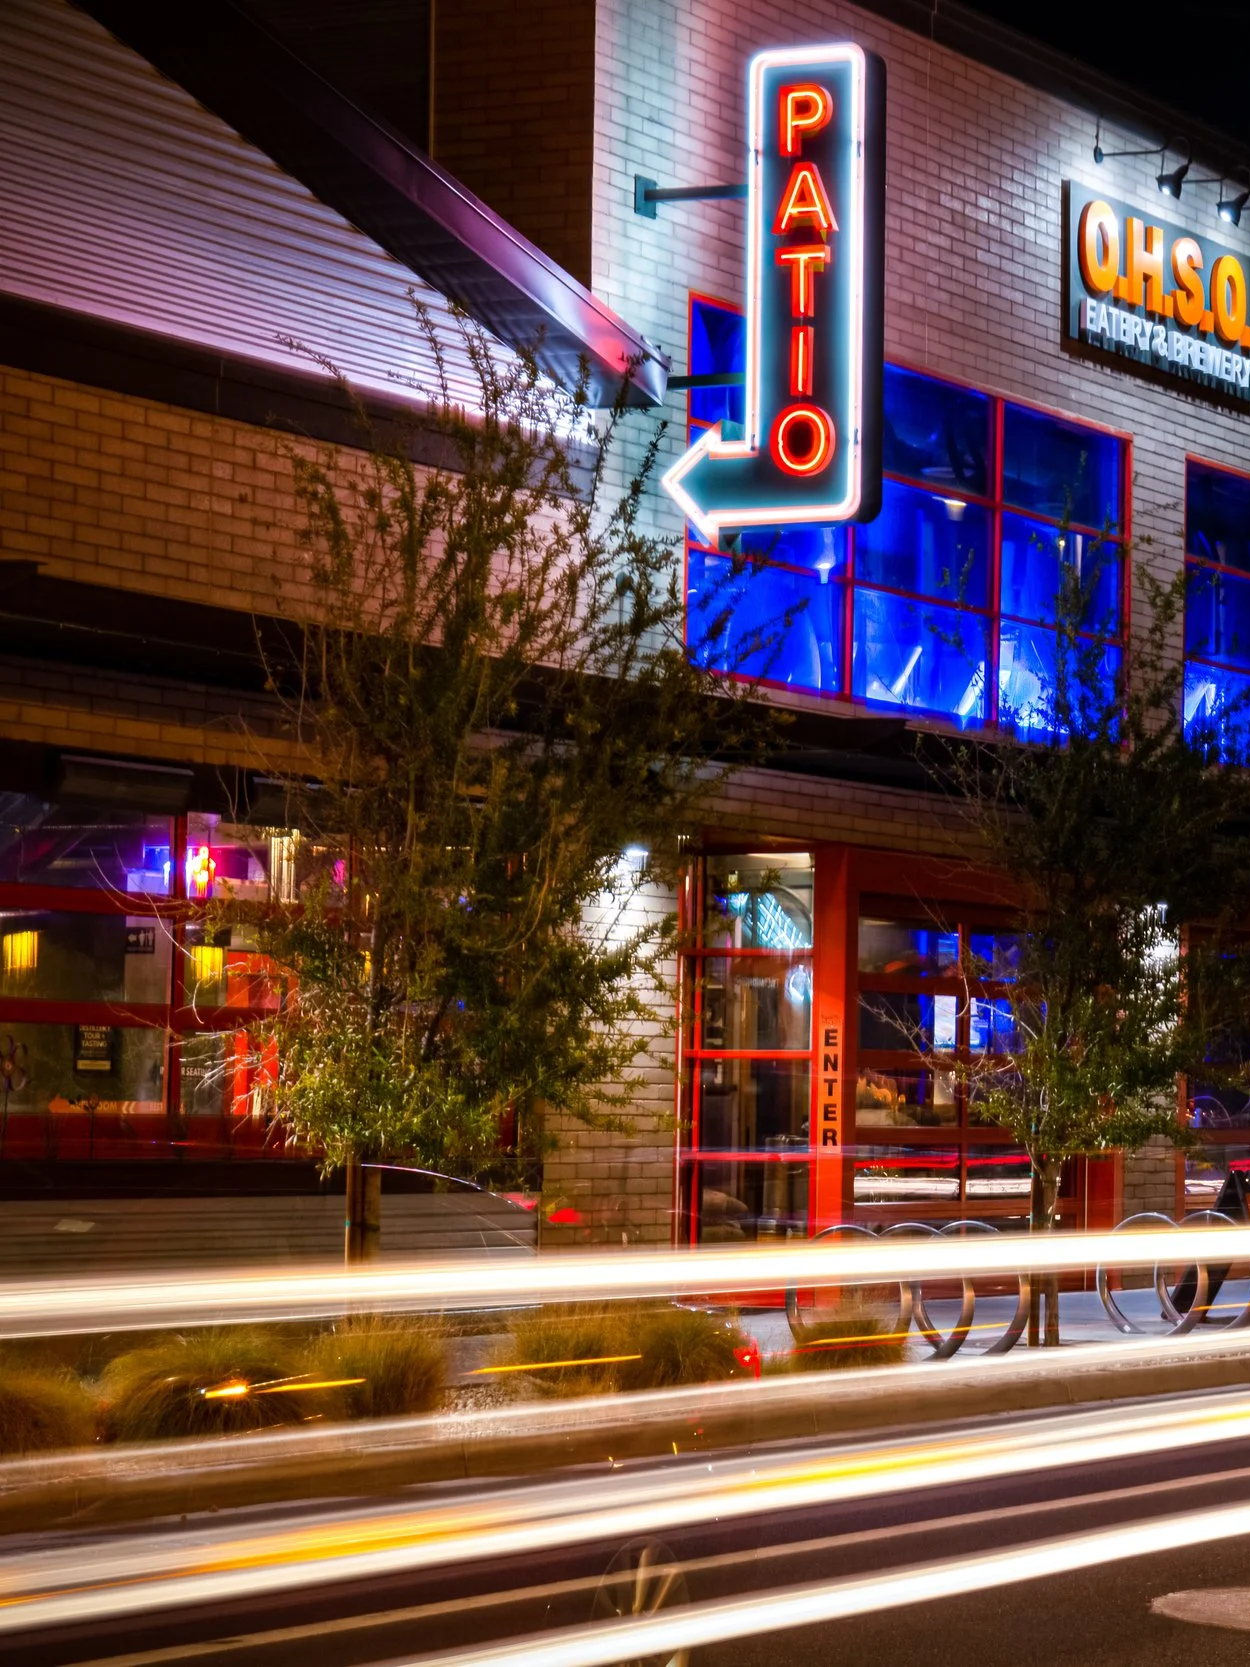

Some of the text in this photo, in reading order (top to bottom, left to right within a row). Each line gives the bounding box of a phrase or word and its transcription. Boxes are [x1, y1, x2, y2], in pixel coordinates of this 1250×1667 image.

[770, 83, 838, 477] PATIO
[1080, 297, 1153, 351] EATERY
[1152, 325, 1168, 358] &
[822, 1028, 838, 1147] ENTER
